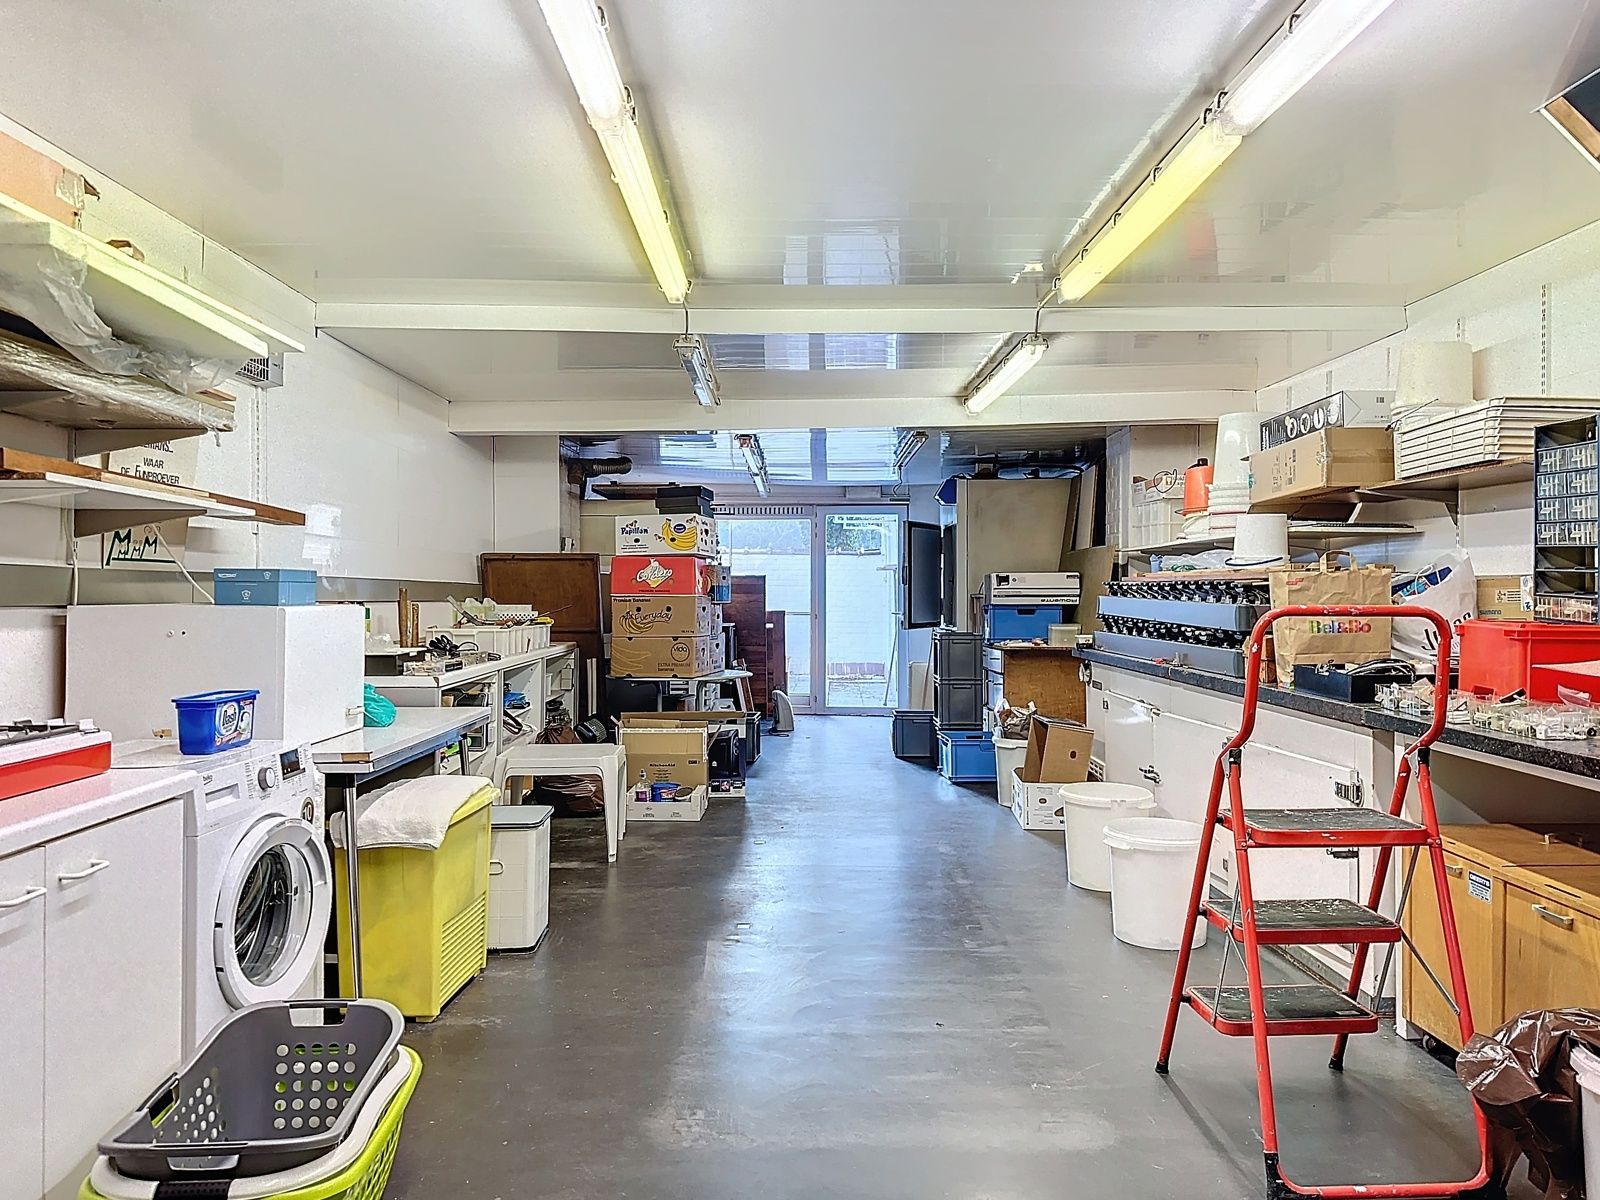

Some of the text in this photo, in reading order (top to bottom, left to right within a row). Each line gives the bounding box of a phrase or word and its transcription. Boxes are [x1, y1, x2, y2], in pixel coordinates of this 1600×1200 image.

[143, 457, 164, 469] WAAR
[620, 527, 649, 535] Papillon
[635, 609, 673, 624] Everyday
